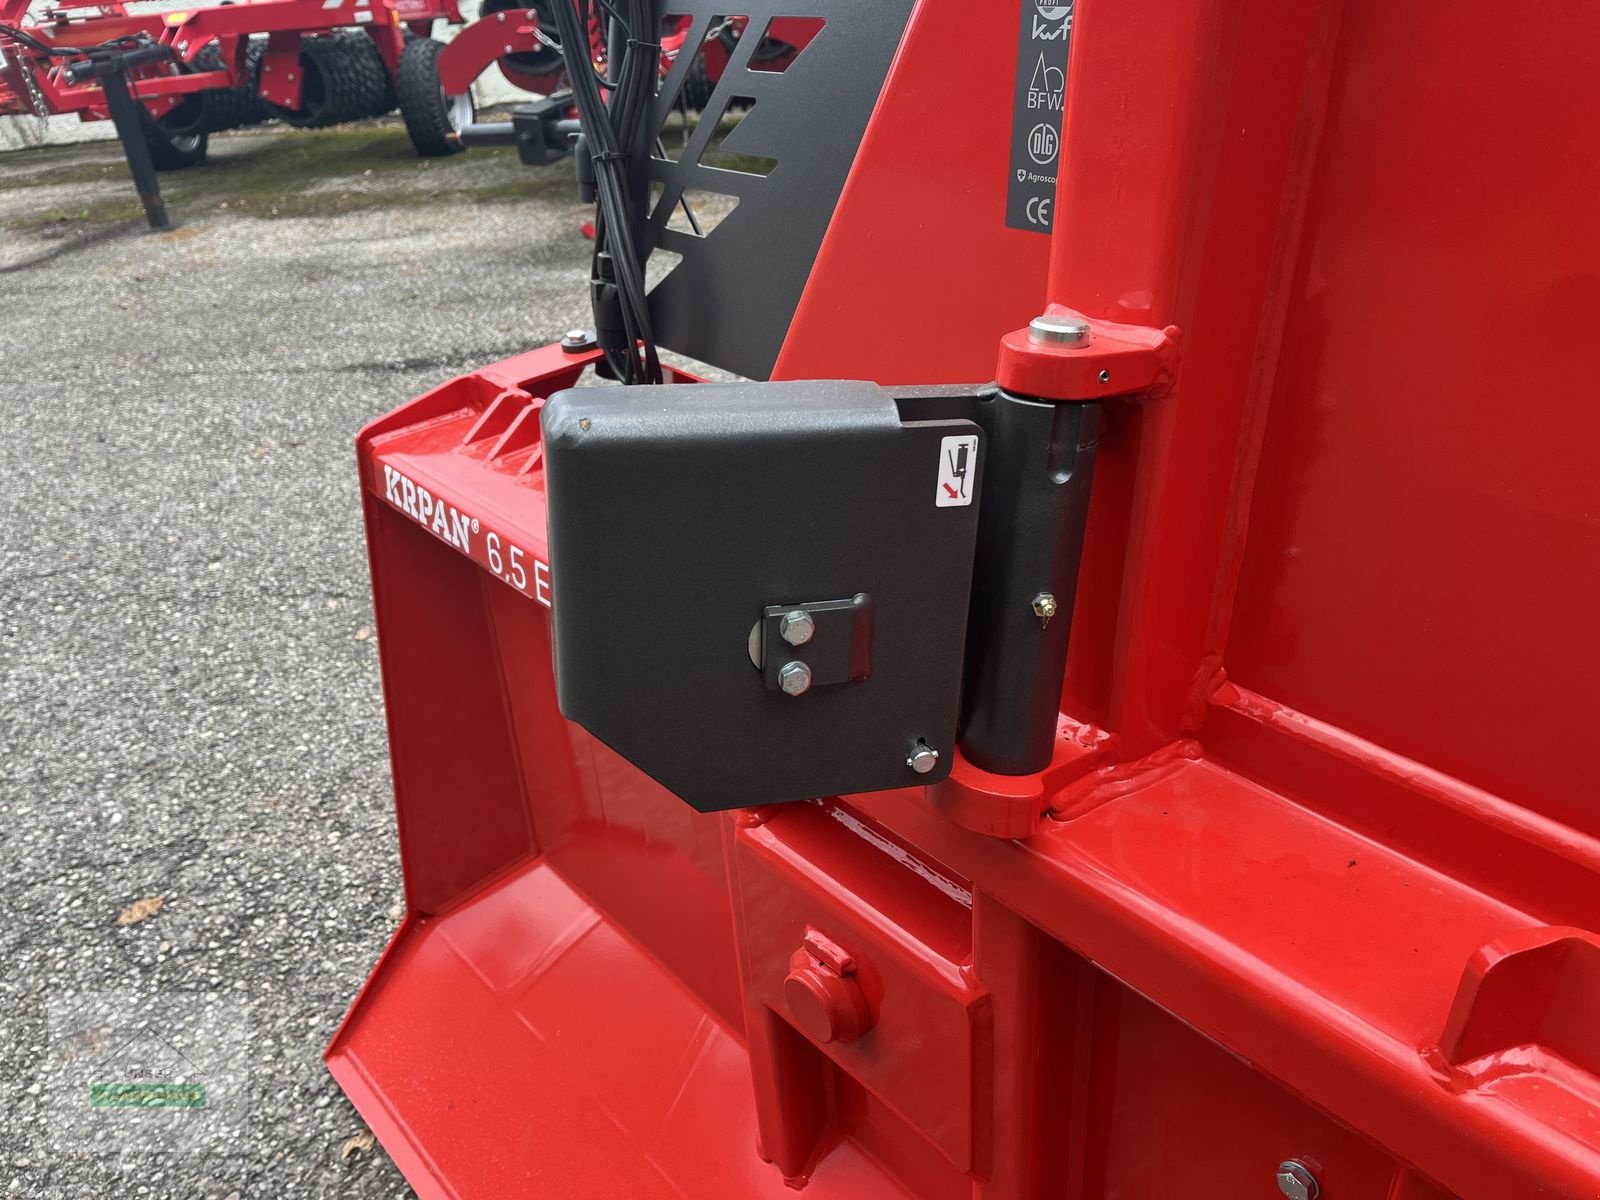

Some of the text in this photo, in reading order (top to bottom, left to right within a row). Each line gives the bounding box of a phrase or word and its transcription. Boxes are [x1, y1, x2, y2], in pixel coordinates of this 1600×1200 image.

[1033, 126, 1053, 156] DLG
[1026, 196, 1051, 226] CE
[486, 532, 527, 590] 6,5
[534, 560, 552, 608] E
